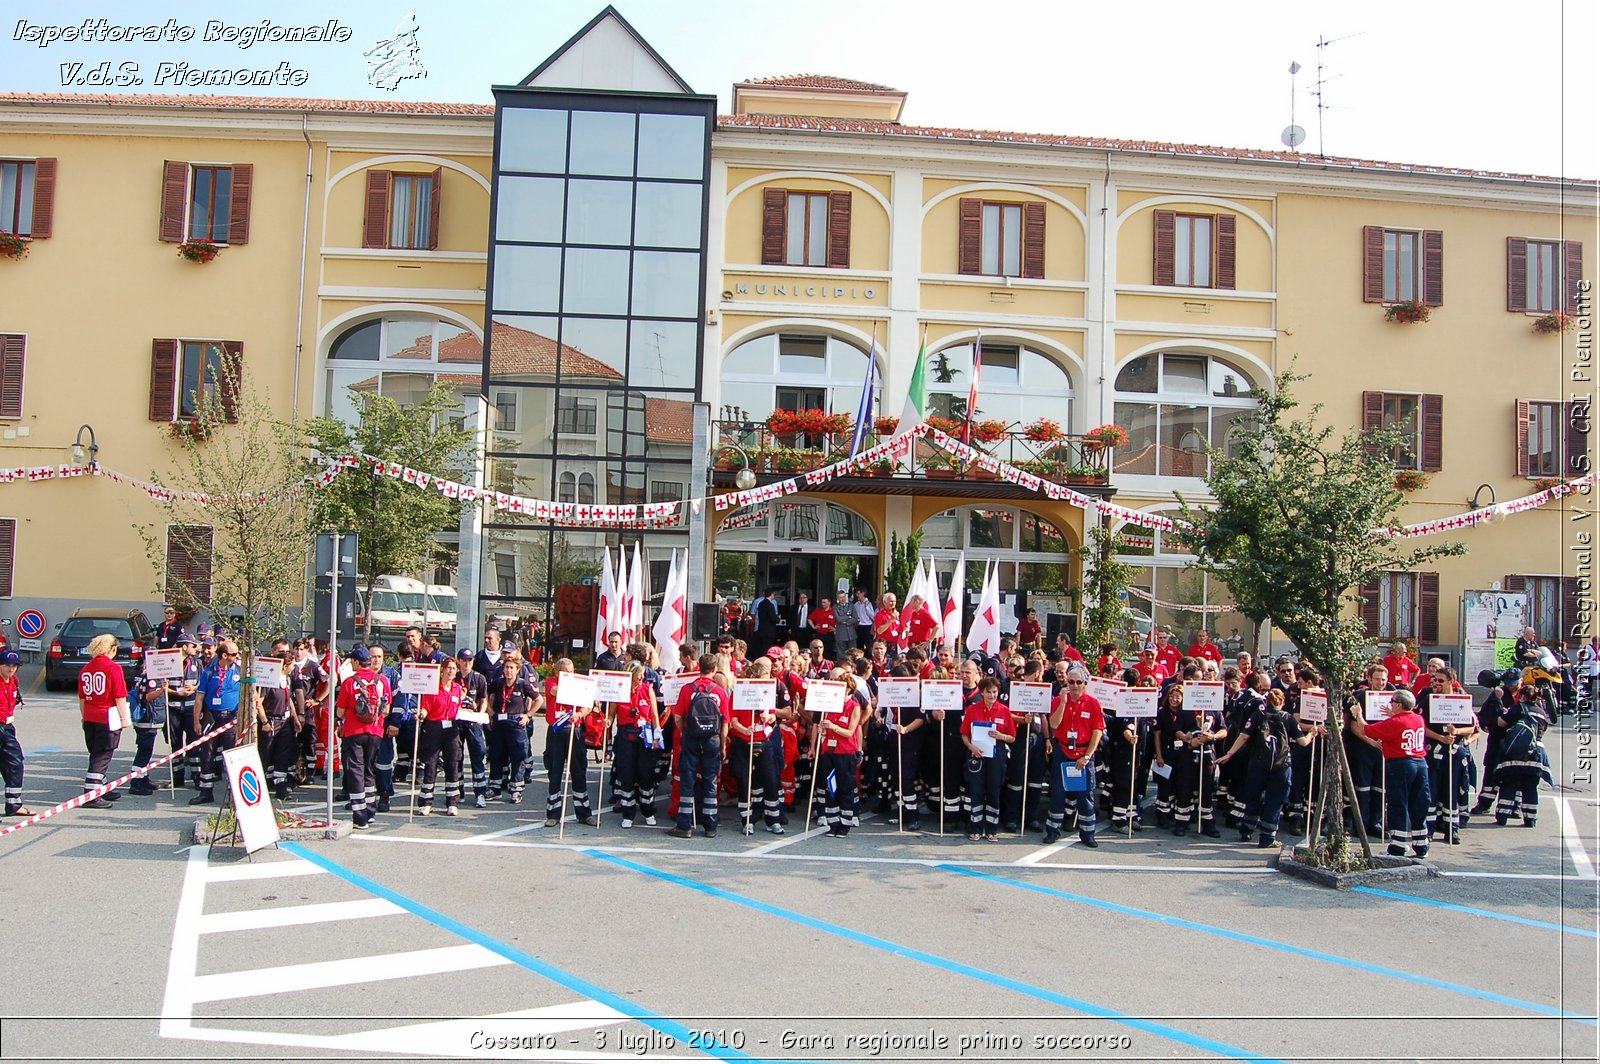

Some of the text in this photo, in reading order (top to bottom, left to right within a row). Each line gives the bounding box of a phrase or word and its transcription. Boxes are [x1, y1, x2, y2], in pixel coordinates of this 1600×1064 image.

[736, 283, 877, 299] MUNICIPIO
[81, 671, 106, 696] 30
[1401, 727, 1425, 752] 30
